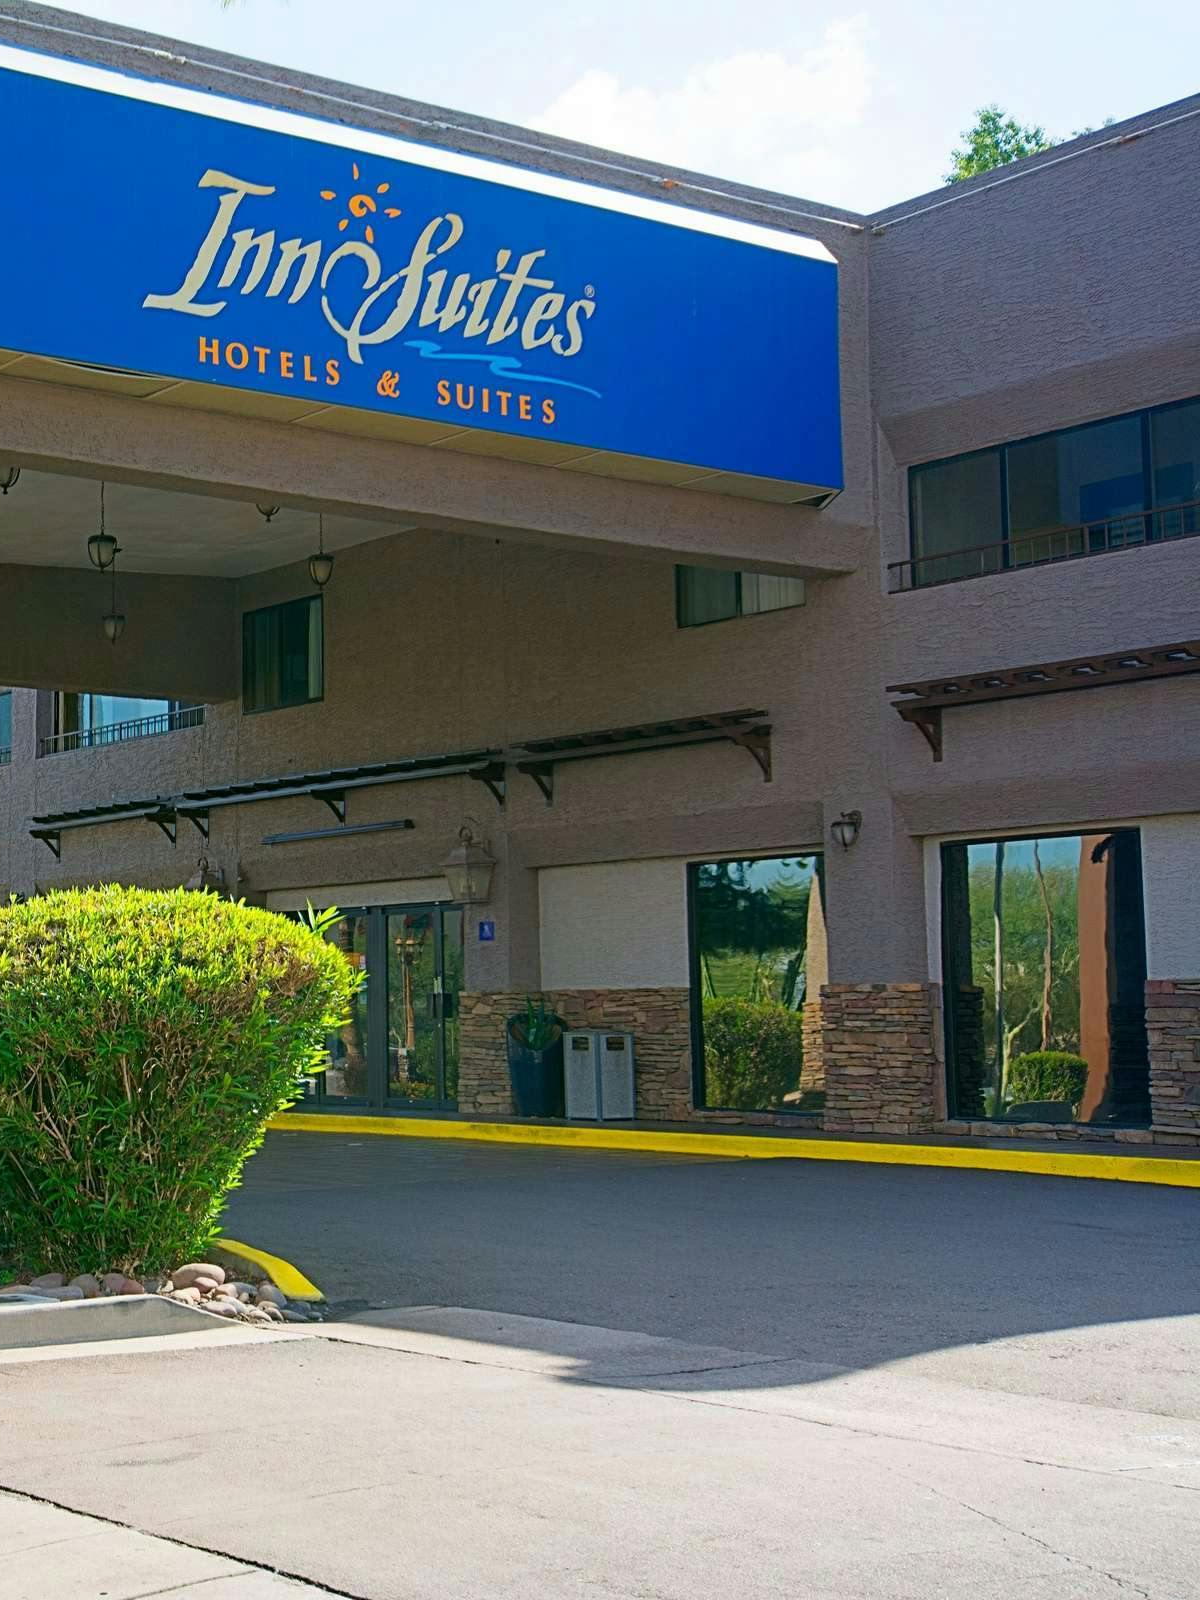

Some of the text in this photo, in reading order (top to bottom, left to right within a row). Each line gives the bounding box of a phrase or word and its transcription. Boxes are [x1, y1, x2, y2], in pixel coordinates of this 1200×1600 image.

[199, 336, 557, 424] HOTELS & SUITES
